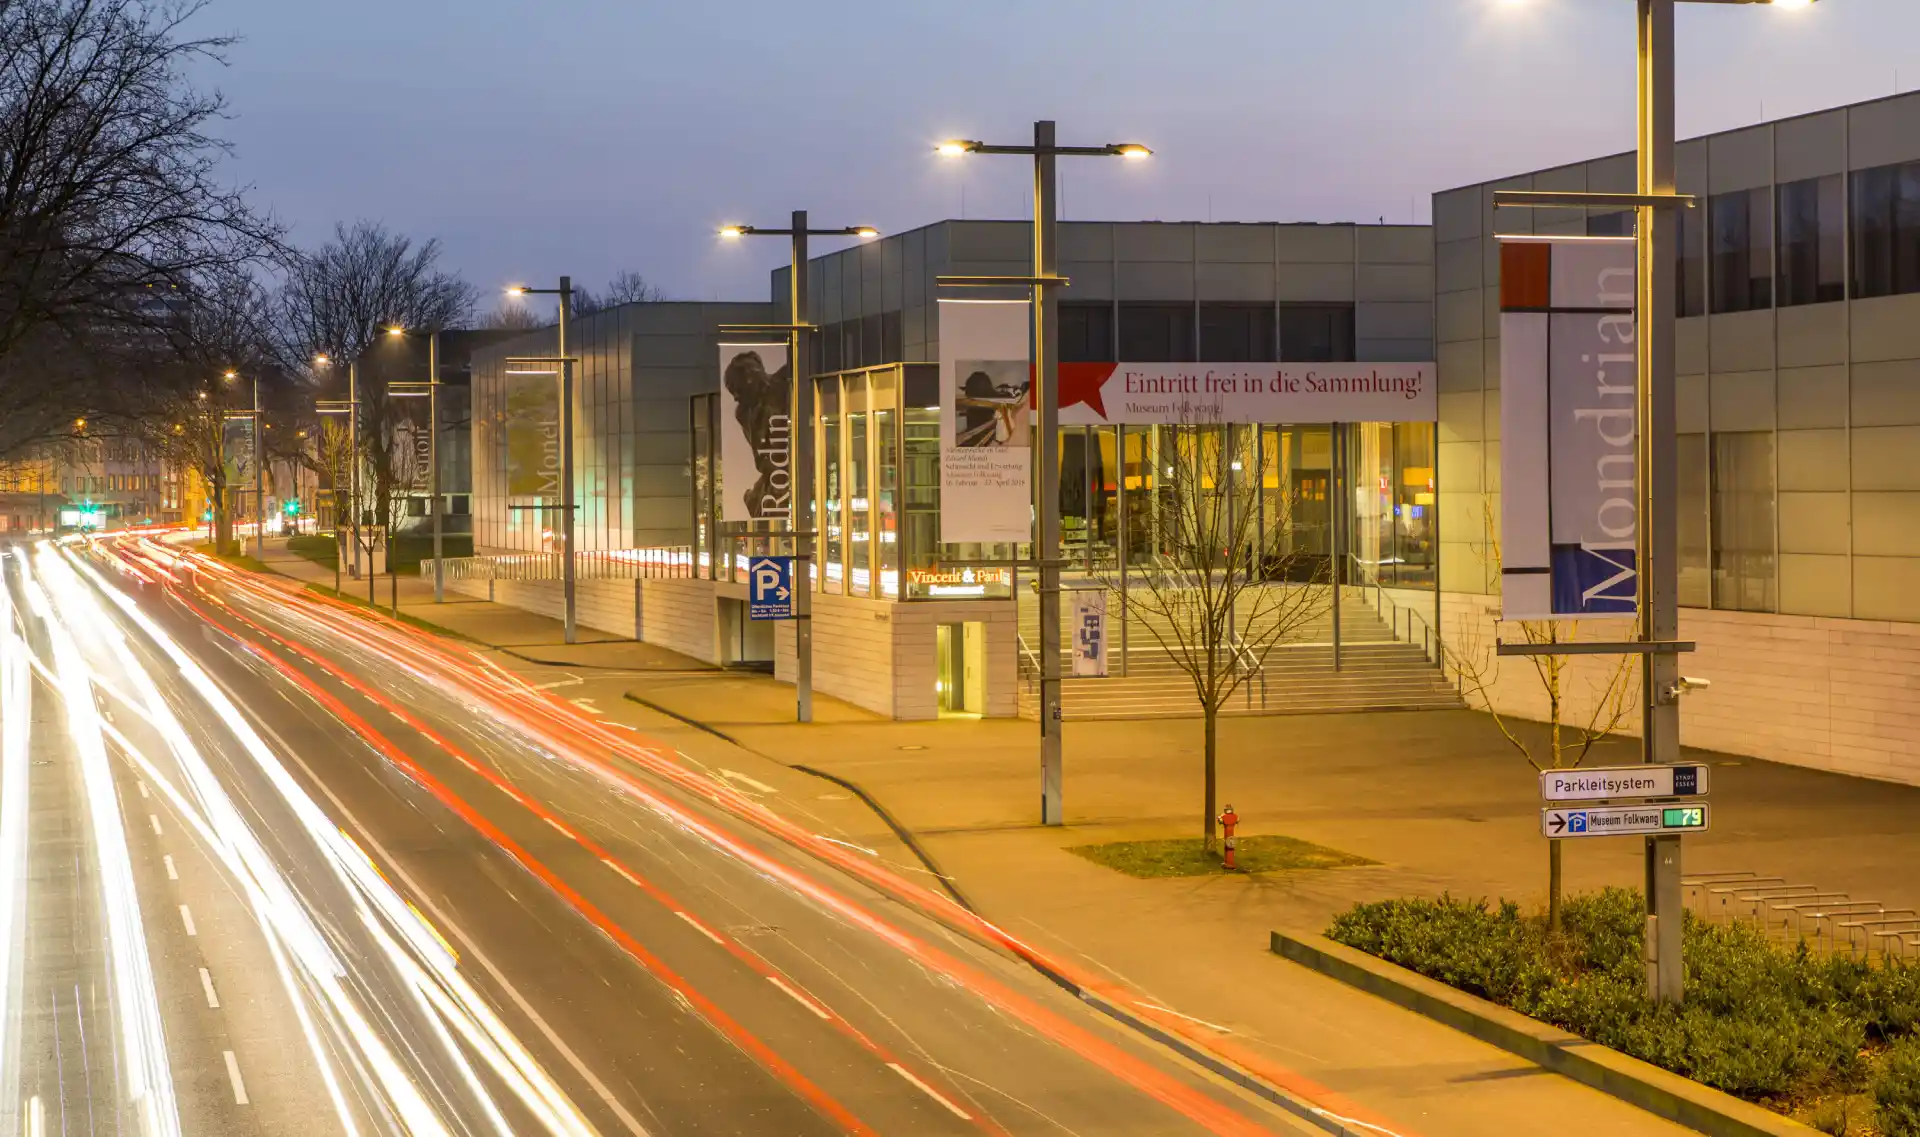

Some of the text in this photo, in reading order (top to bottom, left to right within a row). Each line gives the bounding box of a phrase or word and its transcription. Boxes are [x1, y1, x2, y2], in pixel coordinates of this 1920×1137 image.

[1125, 370, 1423, 399] Eintritt frei in die Sammlung!
[1125, 402, 1169, 413] Museum
[1575, 267, 1636, 604] Mondrian
[537, 419, 560, 494] Monet
[758, 415, 791, 517] Rodin
[757, 570, 779, 600] P
[911, 568, 1004, 583] Vincent & Paul
[1555, 777, 1655, 794] Parkleitsystem
[1590, 814, 1621, 826] Museum
[1624, 813, 1659, 827] Folkwang
[1682, 809, 1702, 826] 79
